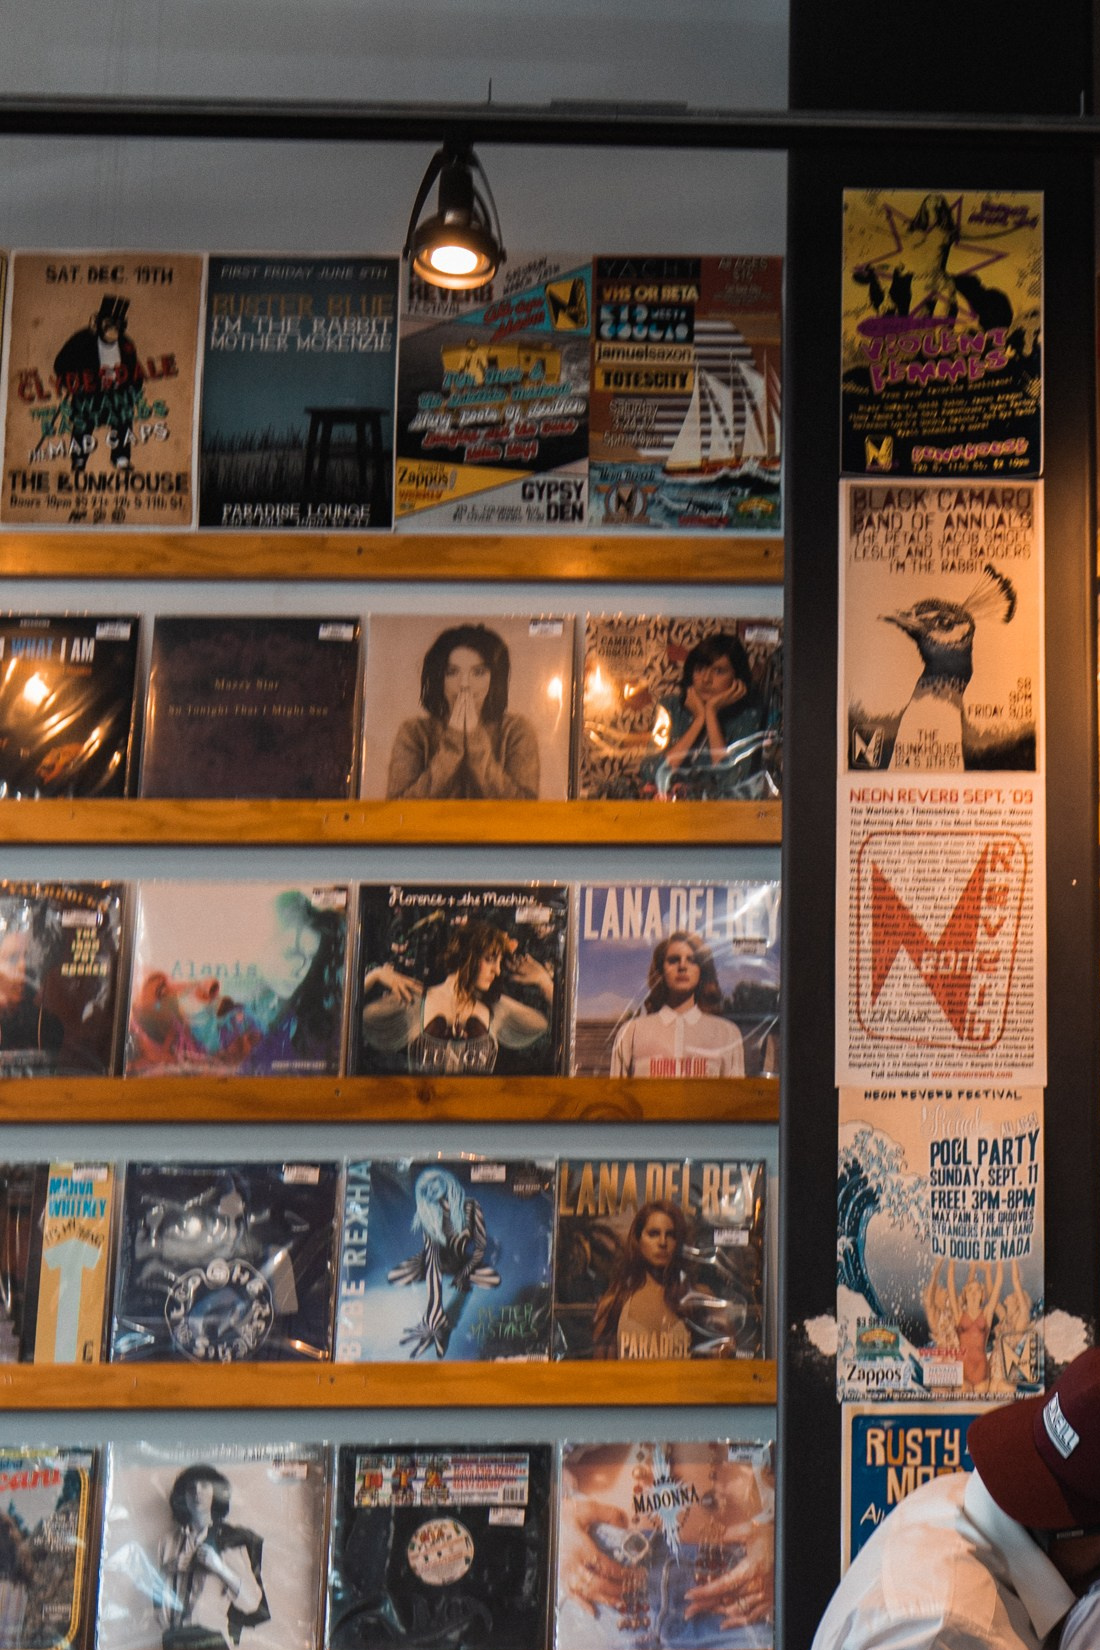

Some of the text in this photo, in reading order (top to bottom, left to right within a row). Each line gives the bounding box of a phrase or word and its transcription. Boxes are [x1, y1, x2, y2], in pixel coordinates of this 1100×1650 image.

[221, 265, 352, 280] FIRST FRIDAY JUNE
[602, 285, 699, 300] VHS OR BETA
[328, 294, 393, 318] BLUE
[256, 317, 300, 333] THE
[312, 316, 393, 333] RABBIT
[210, 334, 288, 352] MOTHER
[861, 327, 1008, 361] VIOLENT
[18, 353, 178, 402] CLYDESDALE
[870, 350, 1008, 393] FEMMES
[48, 434, 97, 460] MAD
[9, 470, 188, 493] THE BUNKHOUSE
[399, 466, 448, 488] Zappos
[521, 480, 584, 501] GYPSY
[852, 488, 1032, 512] BLACK CAMARO
[222, 504, 371, 520] PARADISE LOUNGE
[546, 502, 584, 523] DEN
[853, 511, 1032, 531] BAND OF ANNUALS
[855, 531, 879, 546] THE
[885, 531, 932, 546] PETALS
[939, 531, 980, 545] JACOB
[853, 546, 1032, 562] LESLIE AND THE BADGERS
[912, 559, 983, 574] THE RABBIT
[11, 636, 96, 663] WHAT I AM
[600, 635, 643, 647] CAMERA
[214, 677, 280, 692] Mazzy Star
[188, 704, 228, 718] Tonight
[234, 704, 257, 717] That
[272, 704, 304, 718] Might
[309, 704, 329, 717] See
[968, 705, 1004, 719] FRIDAY
[917, 729, 939, 742] THE
[895, 743, 962, 756] BUNKHOUSE
[850, 788, 894, 804] NEON
[898, 788, 959, 804] REVERB
[963, 789, 1006, 805] SEPT.
[850, 806, 960, 816] The Warlocks Themselves
[863, 818, 894, 828] Morning
[896, 818, 914, 827] After
[954, 818, 972, 827] Most
[1001, 818, 1033, 828] Republic
[388, 884, 443, 907] Florence
[482, 890, 536, 908] Machine
[584, 885, 781, 941] LANA DEL REY
[172, 960, 258, 979] Alanis
[421, 1046, 488, 1068] LUNGS
[649, 1056, 710, 1076] BORN TO DIE
[871, 1071, 885, 1079] Full
[886, 1071, 920, 1079] schedule
[864, 1088, 1022, 1101] NEON REVERB FESTIVAL
[930, 1127, 1040, 1168] POOL PARTY
[930, 1168, 984, 1188] SUNDAY,
[1027, 1163, 1039, 1185] 11
[49, 1176, 94, 1196] MARVA
[560, 1161, 760, 1218] LANA DEL REY
[48, 1197, 107, 1219] WHITNEY
[930, 1187, 1036, 1211] FREE! 3PM-8PM
[931, 1210, 1034, 1223] MAX PAIN THE GROOVIES
[931, 1223, 1034, 1238] STRANGERS FAMILY BAND
[932, 1236, 1031, 1260] DJ DOUG DE NADA
[339, 1160, 372, 1363] BEBE REXHA
[619, 1331, 695, 1359] PARADISE
[846, 1363, 902, 1387] Zappos
[866, 1427, 961, 1467] RUSTY
[633, 1484, 701, 1513] MADONNA
